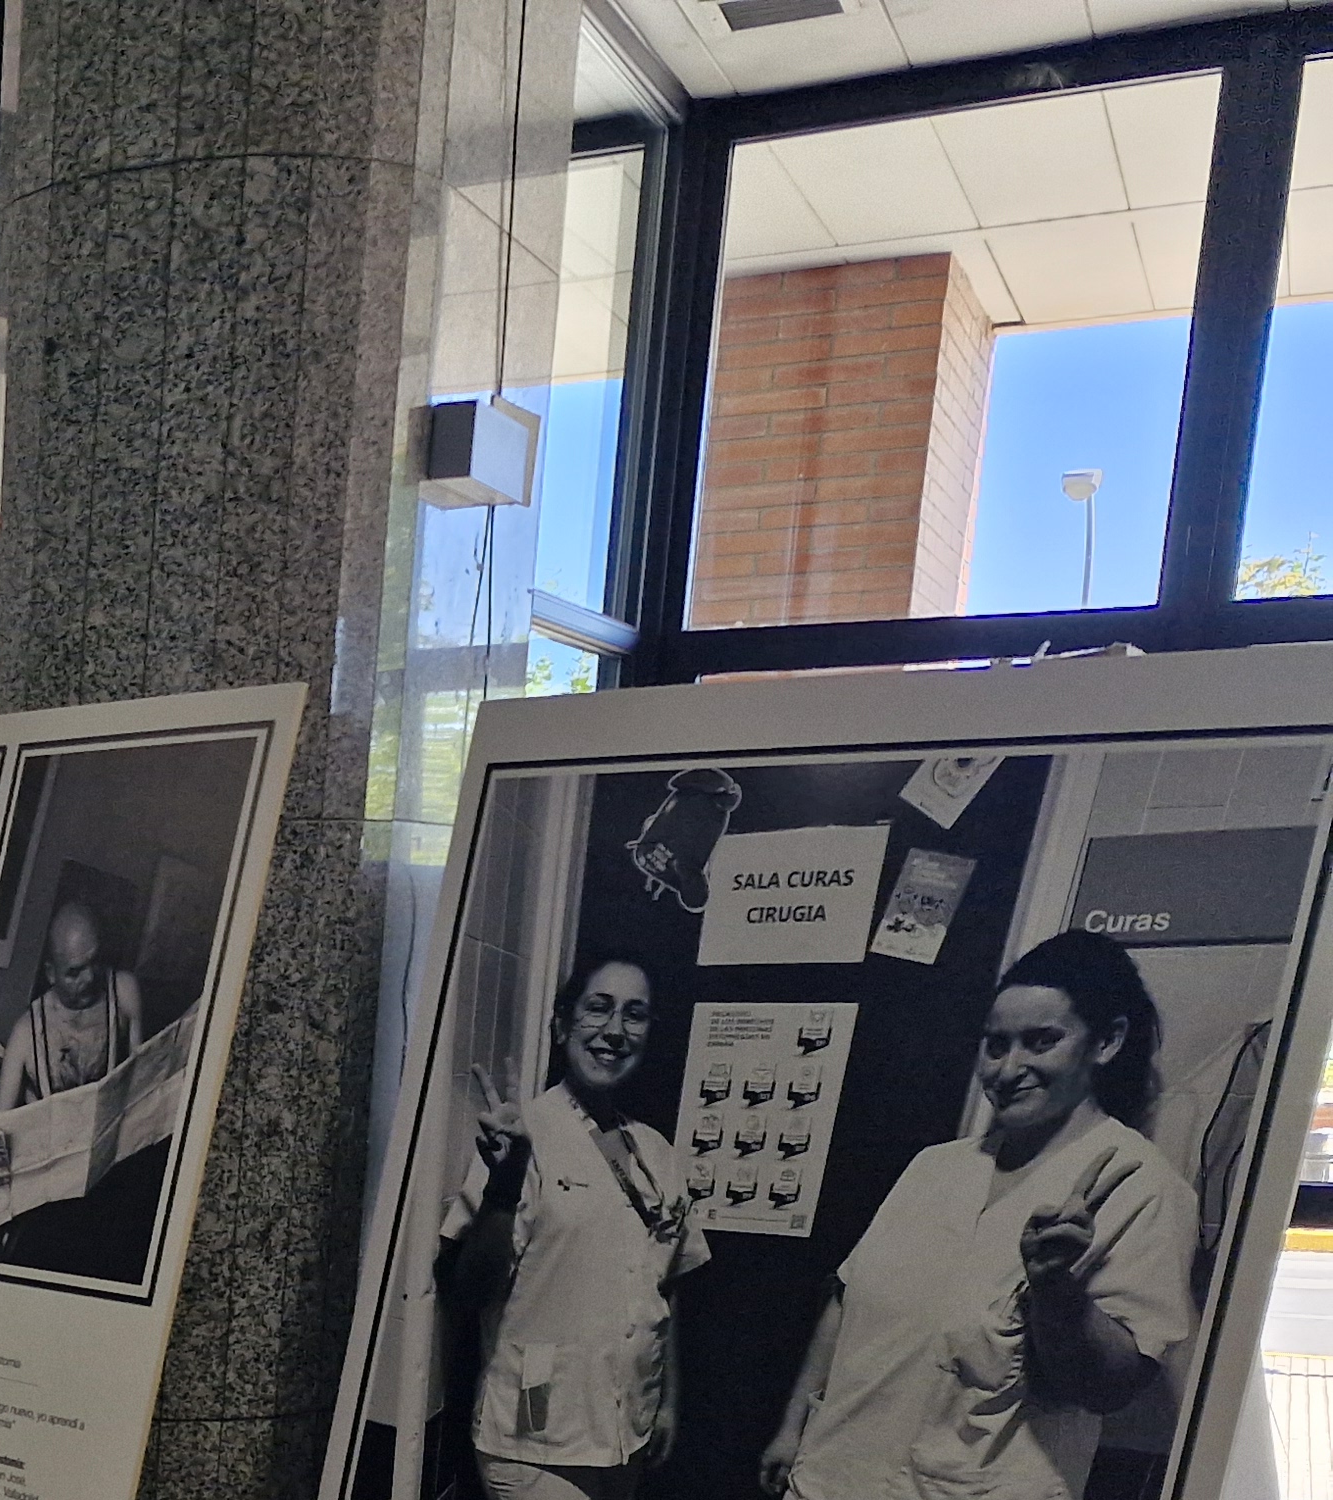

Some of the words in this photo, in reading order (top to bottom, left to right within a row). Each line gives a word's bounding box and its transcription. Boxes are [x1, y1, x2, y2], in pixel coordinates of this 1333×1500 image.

[732, 871, 782, 892] SALA
[787, 868, 855, 889] CURAS
[746, 904, 827, 924] CIRUGIA
[1083, 907, 1171, 935] Curas
